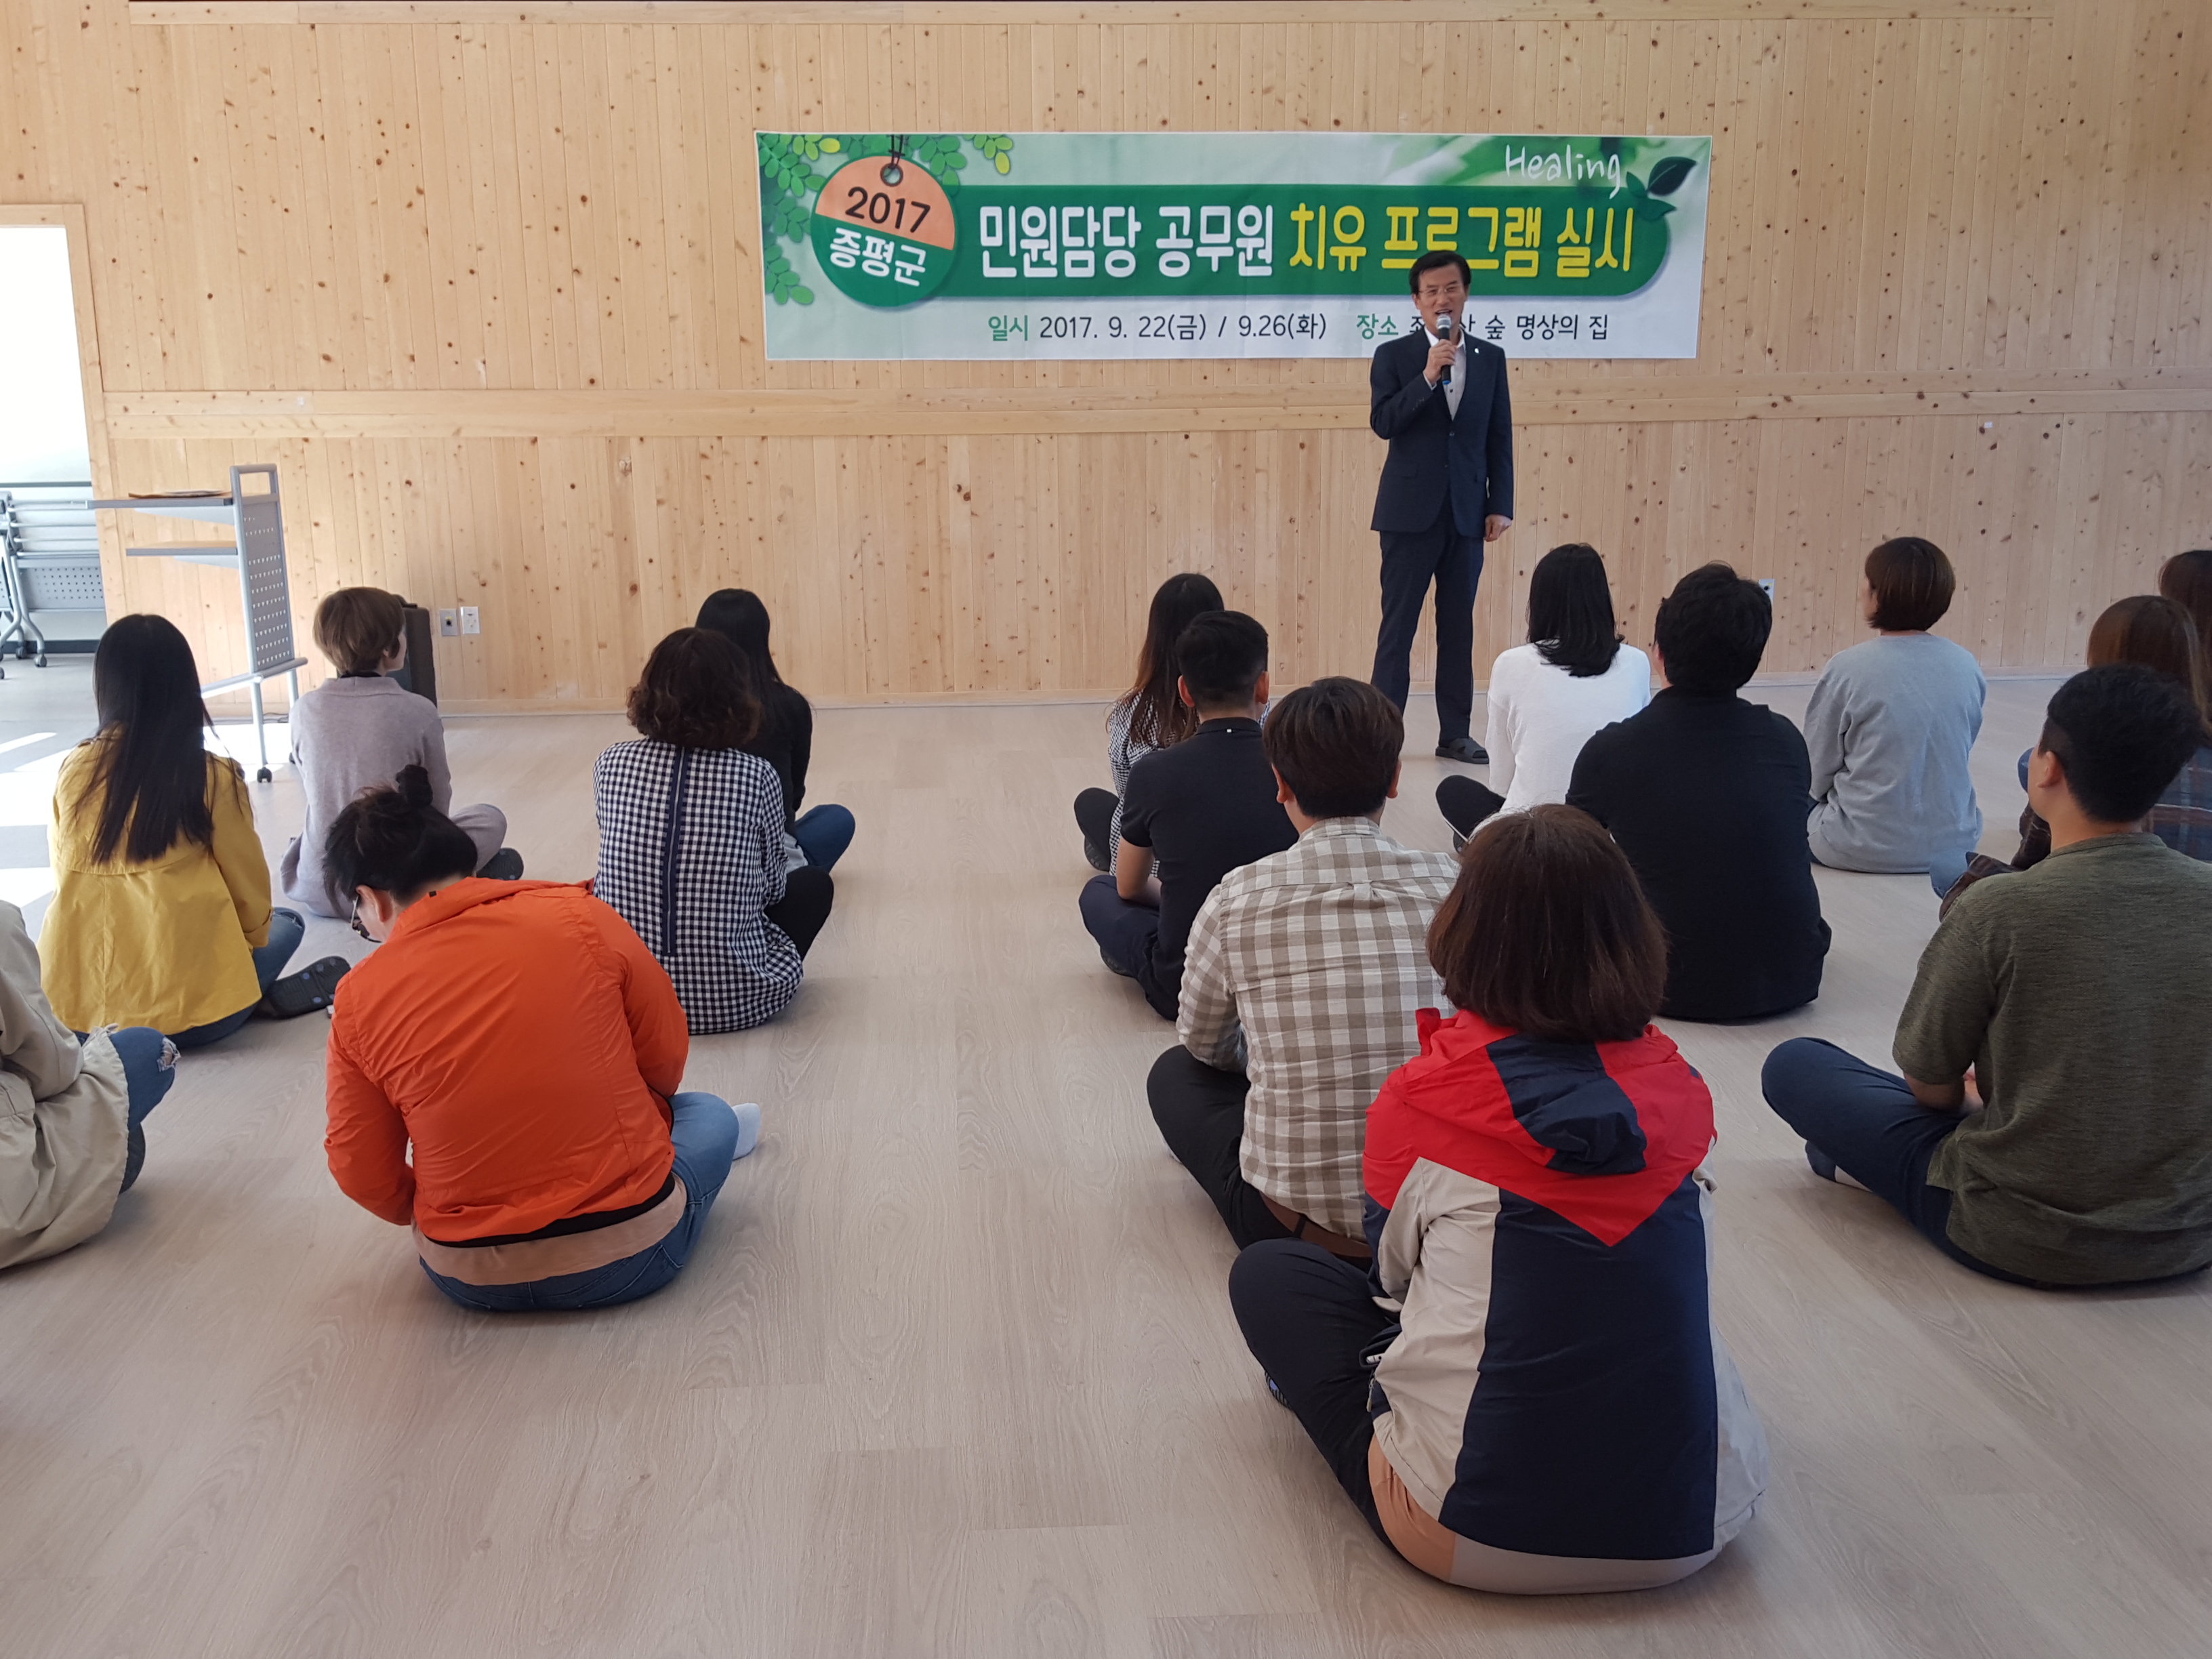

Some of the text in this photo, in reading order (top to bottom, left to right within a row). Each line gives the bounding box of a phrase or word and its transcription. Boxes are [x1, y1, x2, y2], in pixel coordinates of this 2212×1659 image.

[1505, 144, 1622, 199] Healing
[844, 186, 931, 233] 2017
[830, 226, 927, 287] 증평군
[979, 205, 1142, 279] 민원담당
[1155, 204, 1273, 277] 공무원
[1290, 203, 1367, 272] 치유
[1557, 207, 1634, 278] 실시
[987, 314, 1029, 341] 일시
[1040, 316, 1099, 338] 2017.
[1108, 316, 1128, 338] 9.
[1138, 314, 1207, 340] 22(금)
[1238, 313, 1327, 339] 9.26(화)
[1356, 313, 1399, 339] 장소
[1485, 314, 1506, 340] 숲
[1516, 314, 1578, 340] 명상의
[1589, 314, 1608, 340] 집
